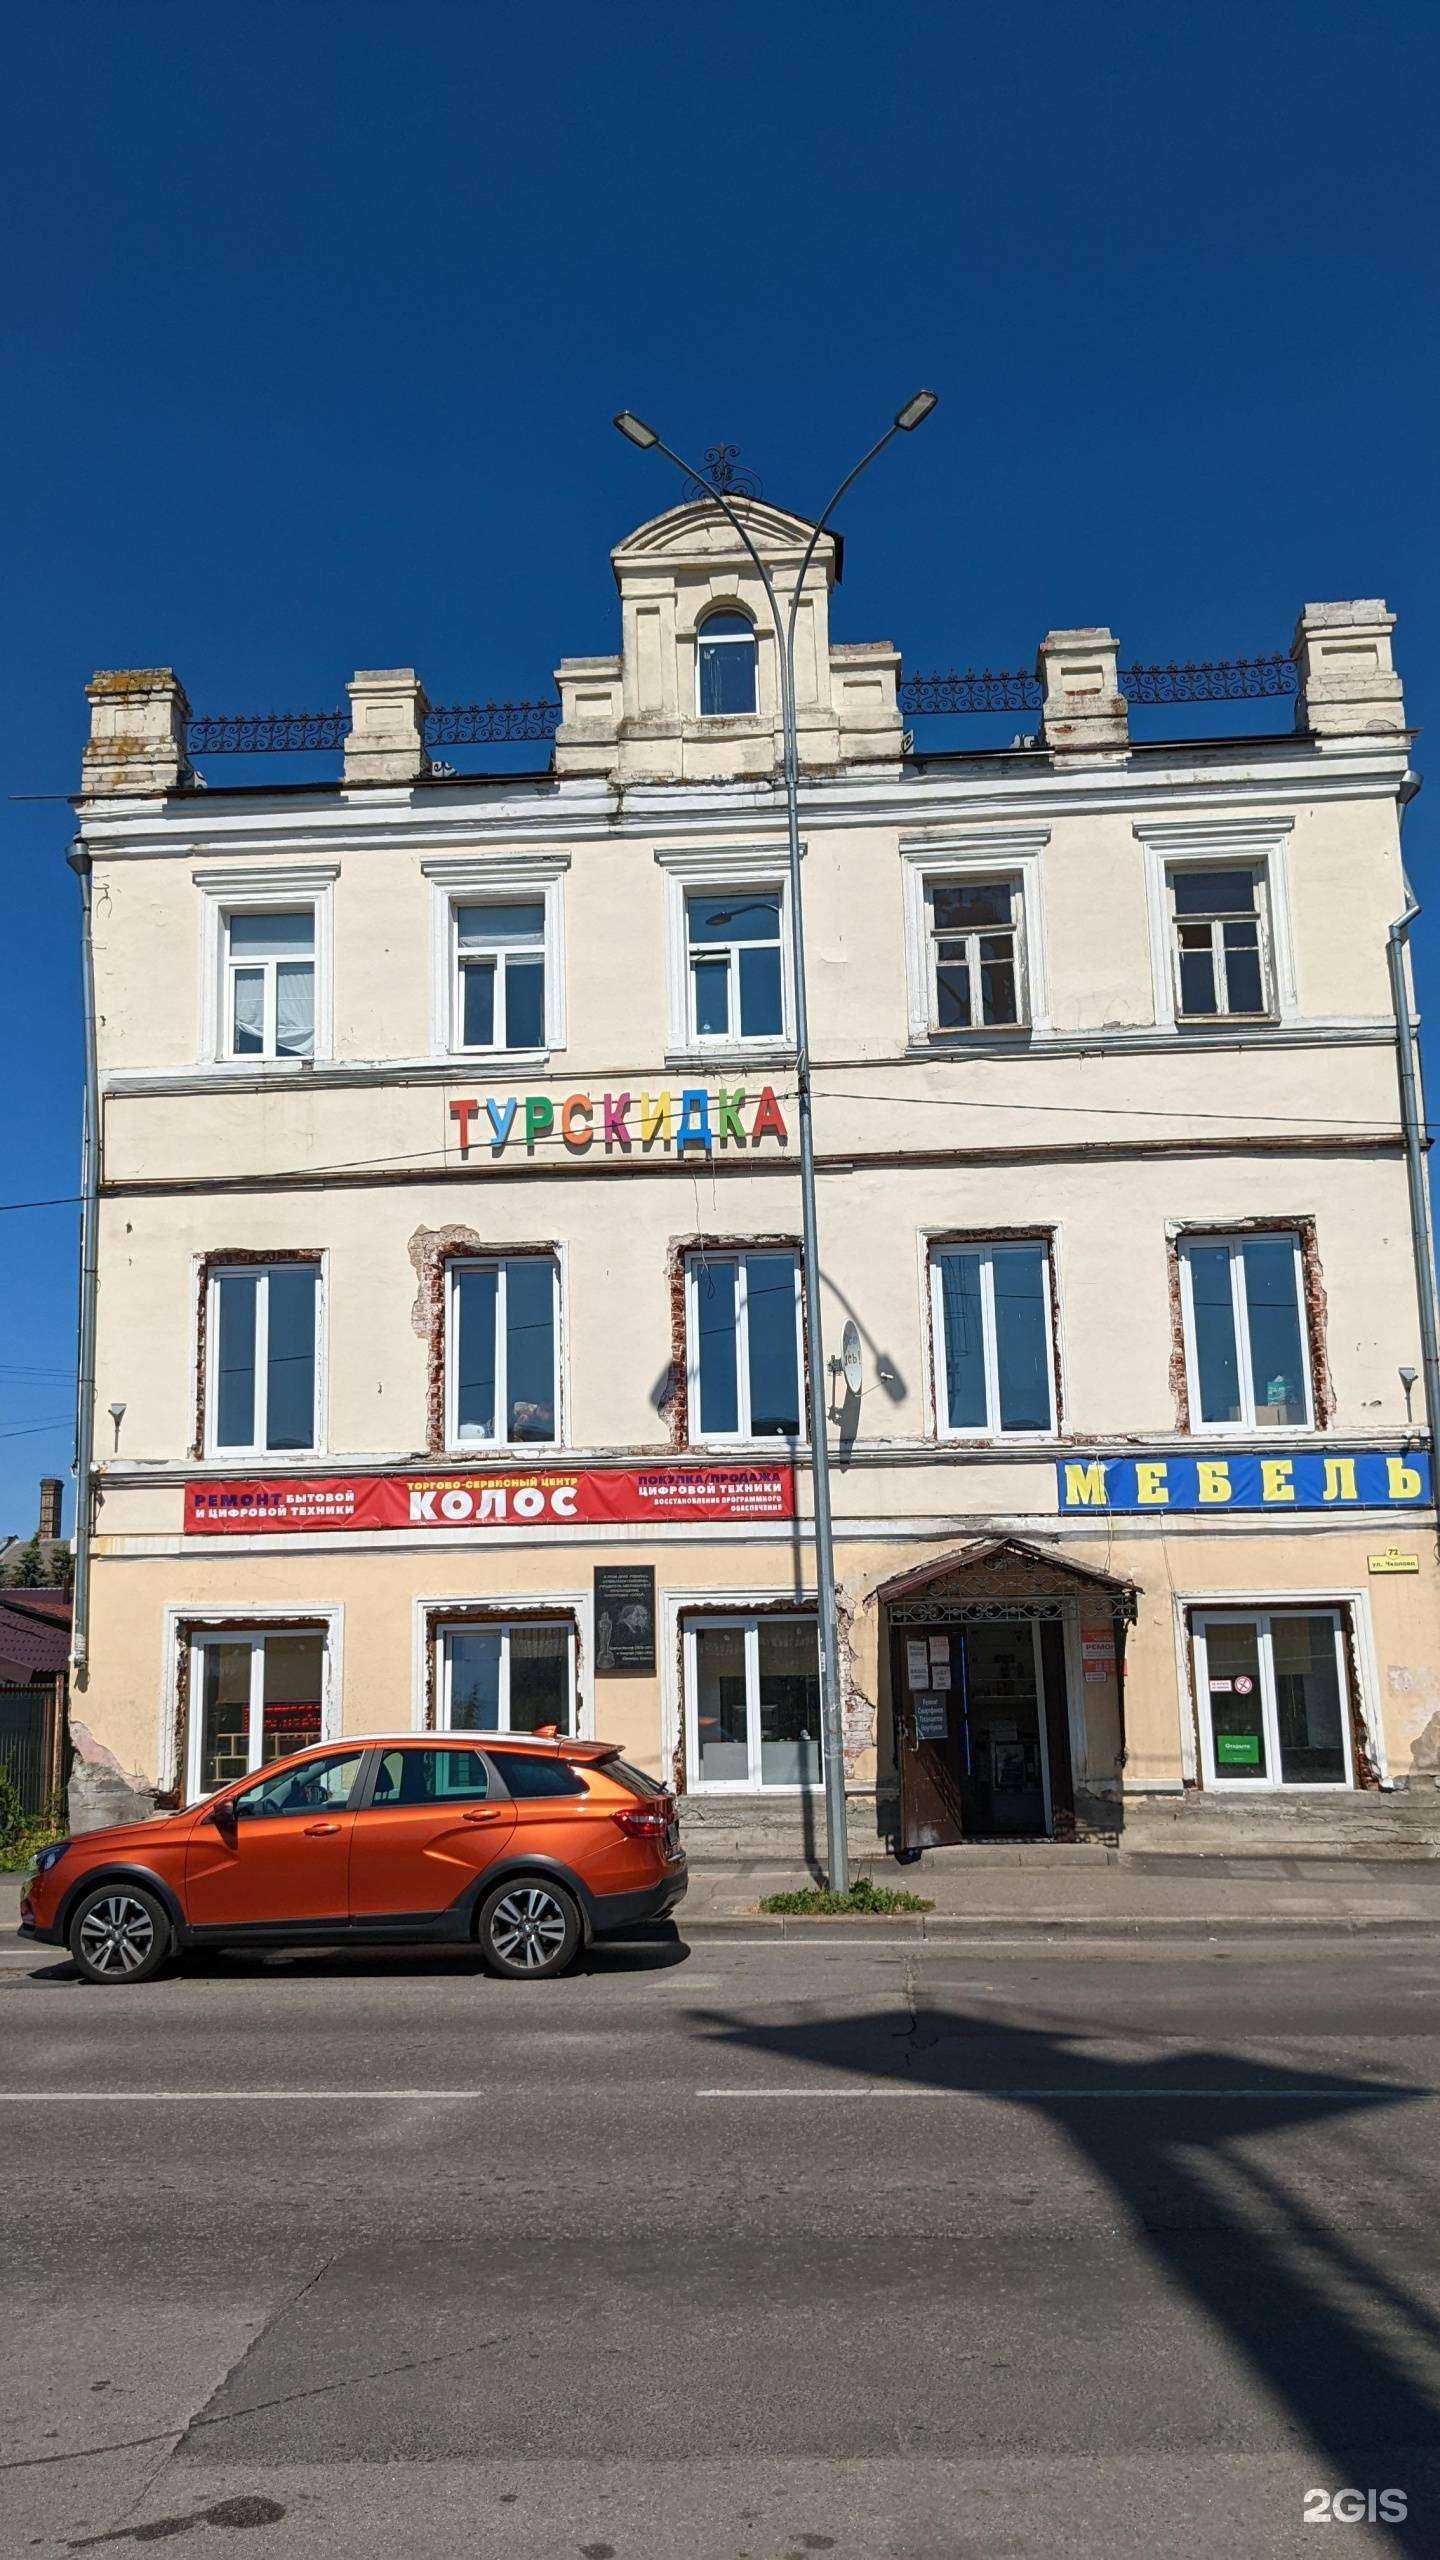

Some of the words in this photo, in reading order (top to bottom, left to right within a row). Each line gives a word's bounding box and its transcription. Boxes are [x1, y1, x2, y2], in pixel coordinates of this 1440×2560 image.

[449, 1086, 788, 1151] ТУРСКИДКА
[407, 1477, 538, 1490] ТОРГОВО-СЕРВИСНЫЙ
[541, 1477, 578, 1488] ЦЕНТР
[638, 1472, 781, 1485] ПОКУПКА/ПРОДАЖА
[1065, 1457, 1422, 1505] МЕБЕЛЬ
[638, 1483, 716, 1496] ЦИФРОВОЙ
[719, 1483, 782, 1494] ТЕХНИКИ
[194, 1493, 283, 1507] РЕМОНТ
[286, 1490, 355, 1504] БЫТОВОЙ
[409, 1486, 578, 1521] КОЛОС
[654, 1497, 720, 1505] ВОССТАНОВЛЕНИЕ
[195, 1509, 204, 1518] И
[208, 1504, 287, 1520] ЦИФРОВОЙ
[291, 1505, 355, 1517] ТЕХНИКИ
